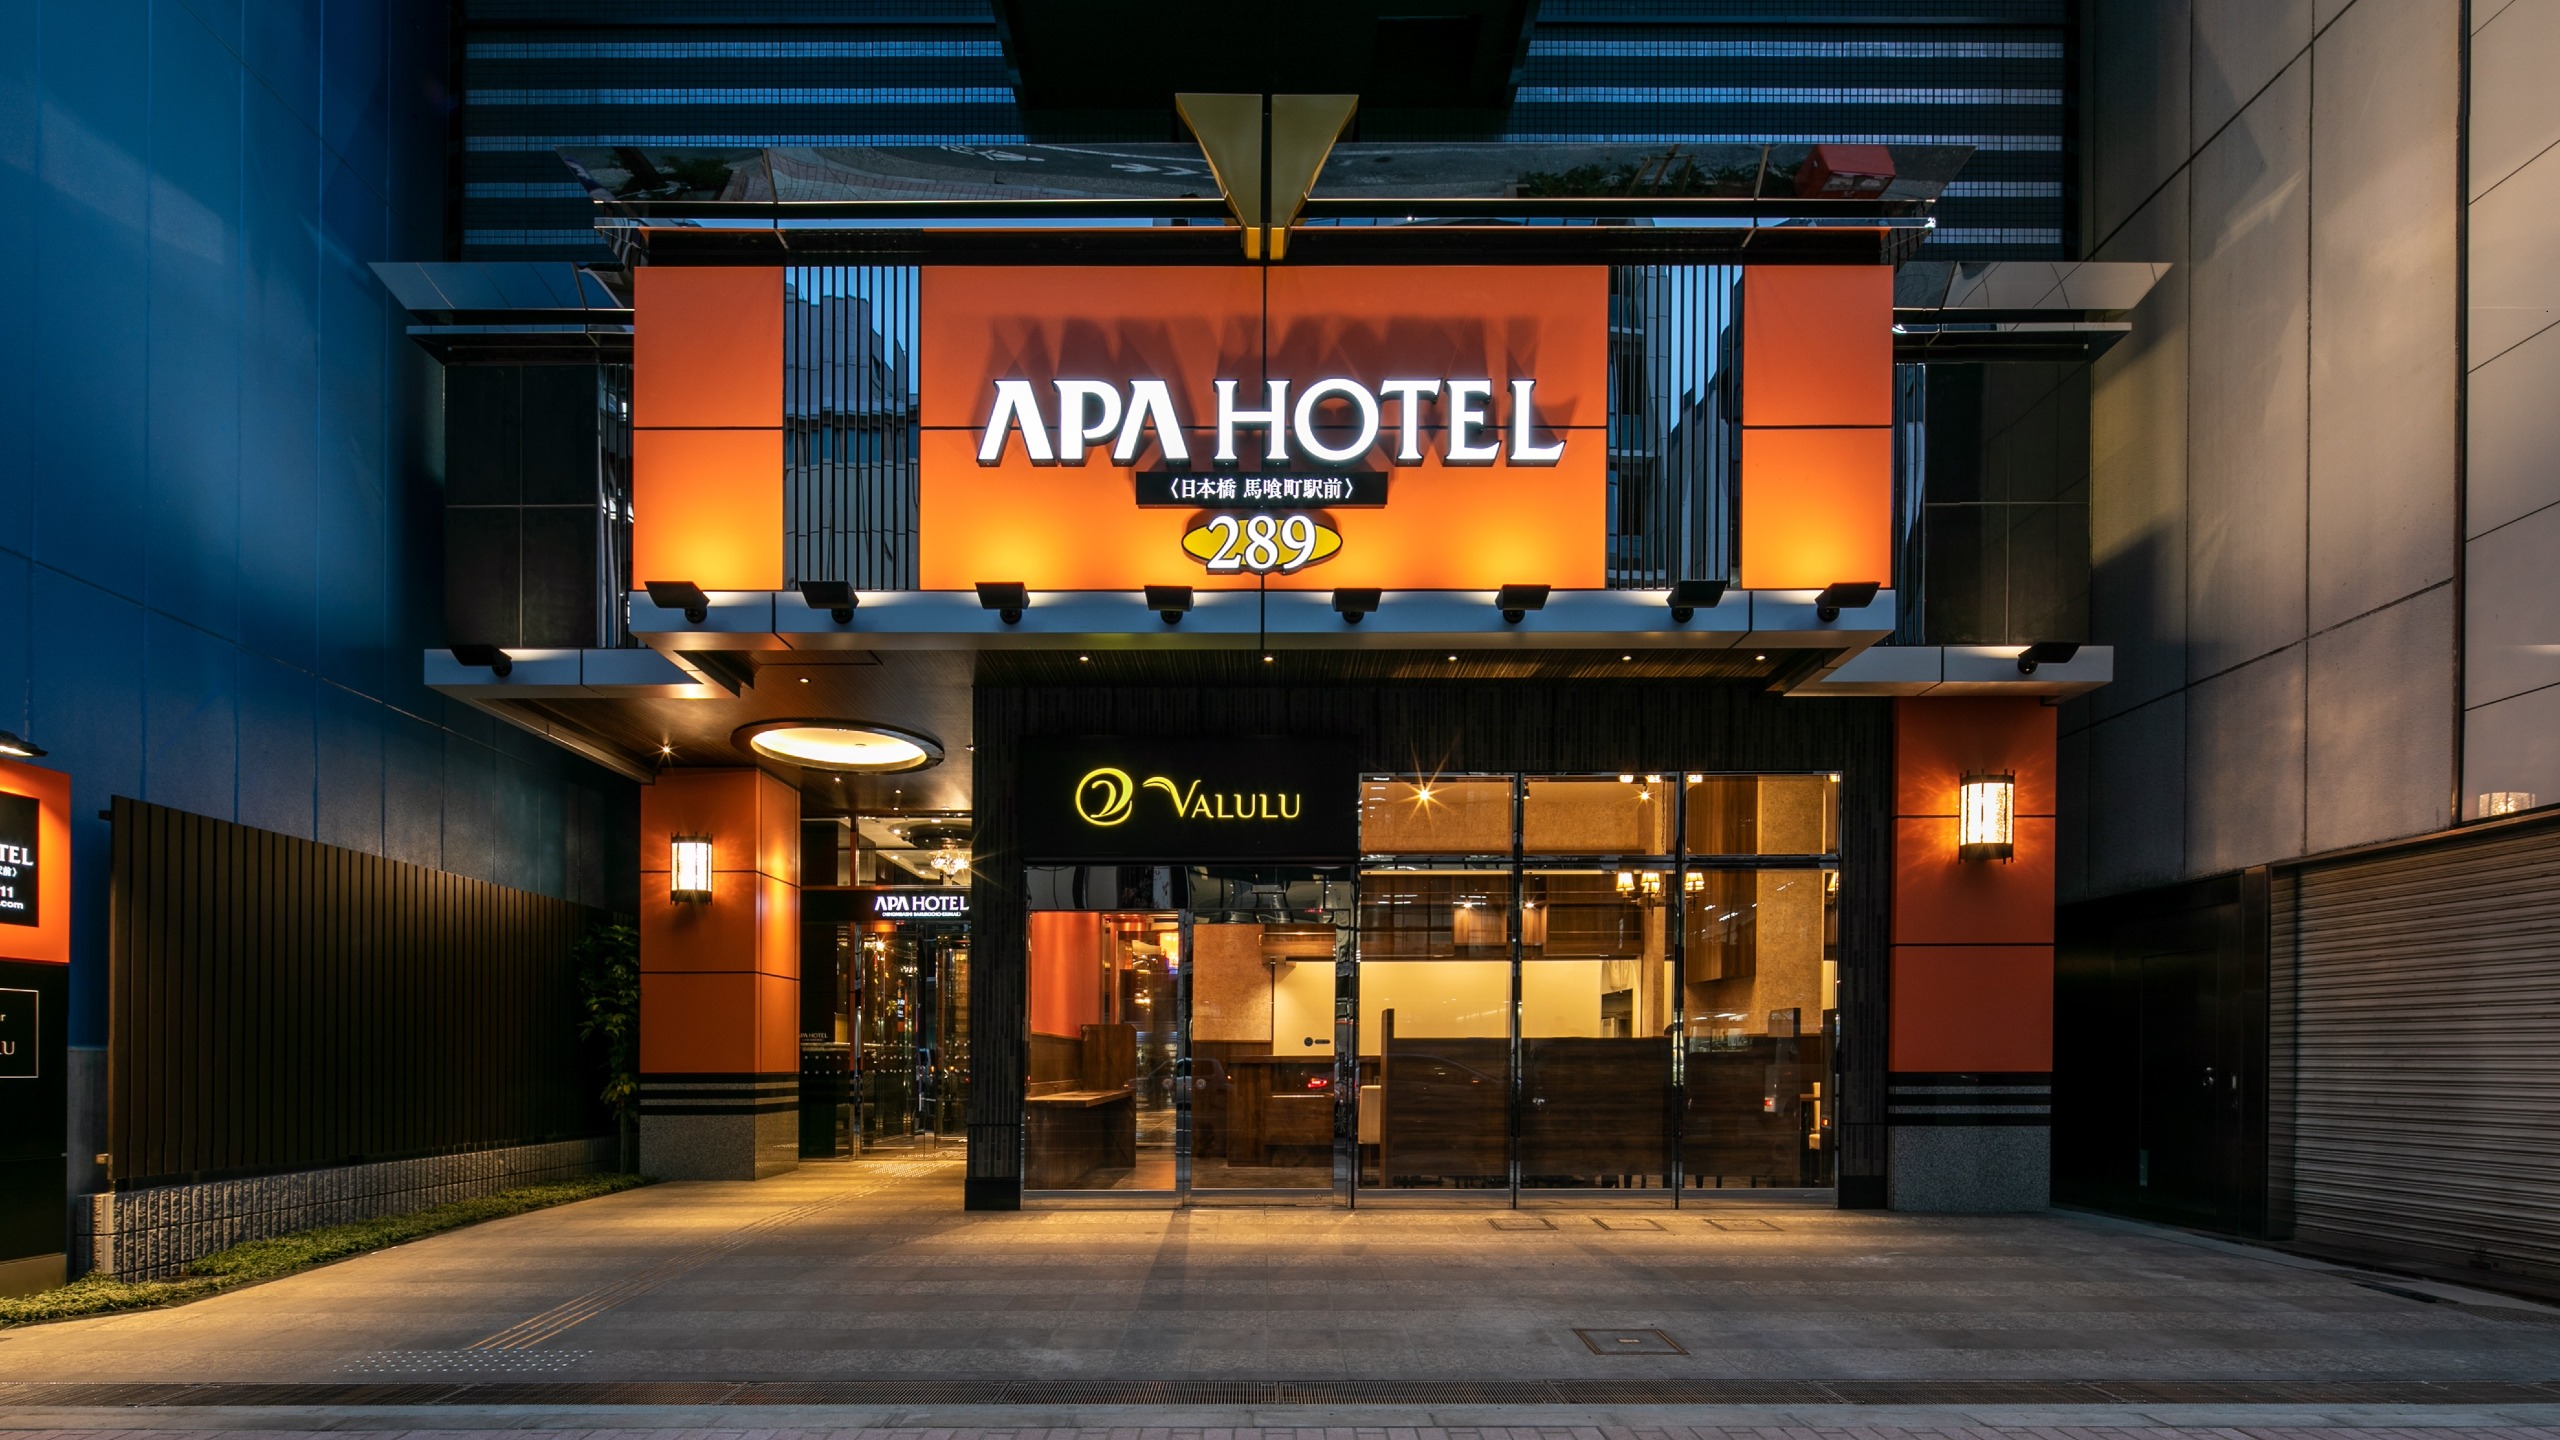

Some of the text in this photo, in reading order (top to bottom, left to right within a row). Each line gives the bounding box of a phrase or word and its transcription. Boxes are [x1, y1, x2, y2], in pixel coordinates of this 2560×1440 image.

[977, 378, 1567, 464] APA HOTEL
[1206, 514, 1316, 570] 289
[1142, 776, 1300, 818] VALULU
[874, 896, 970, 911] APA HOTEL
